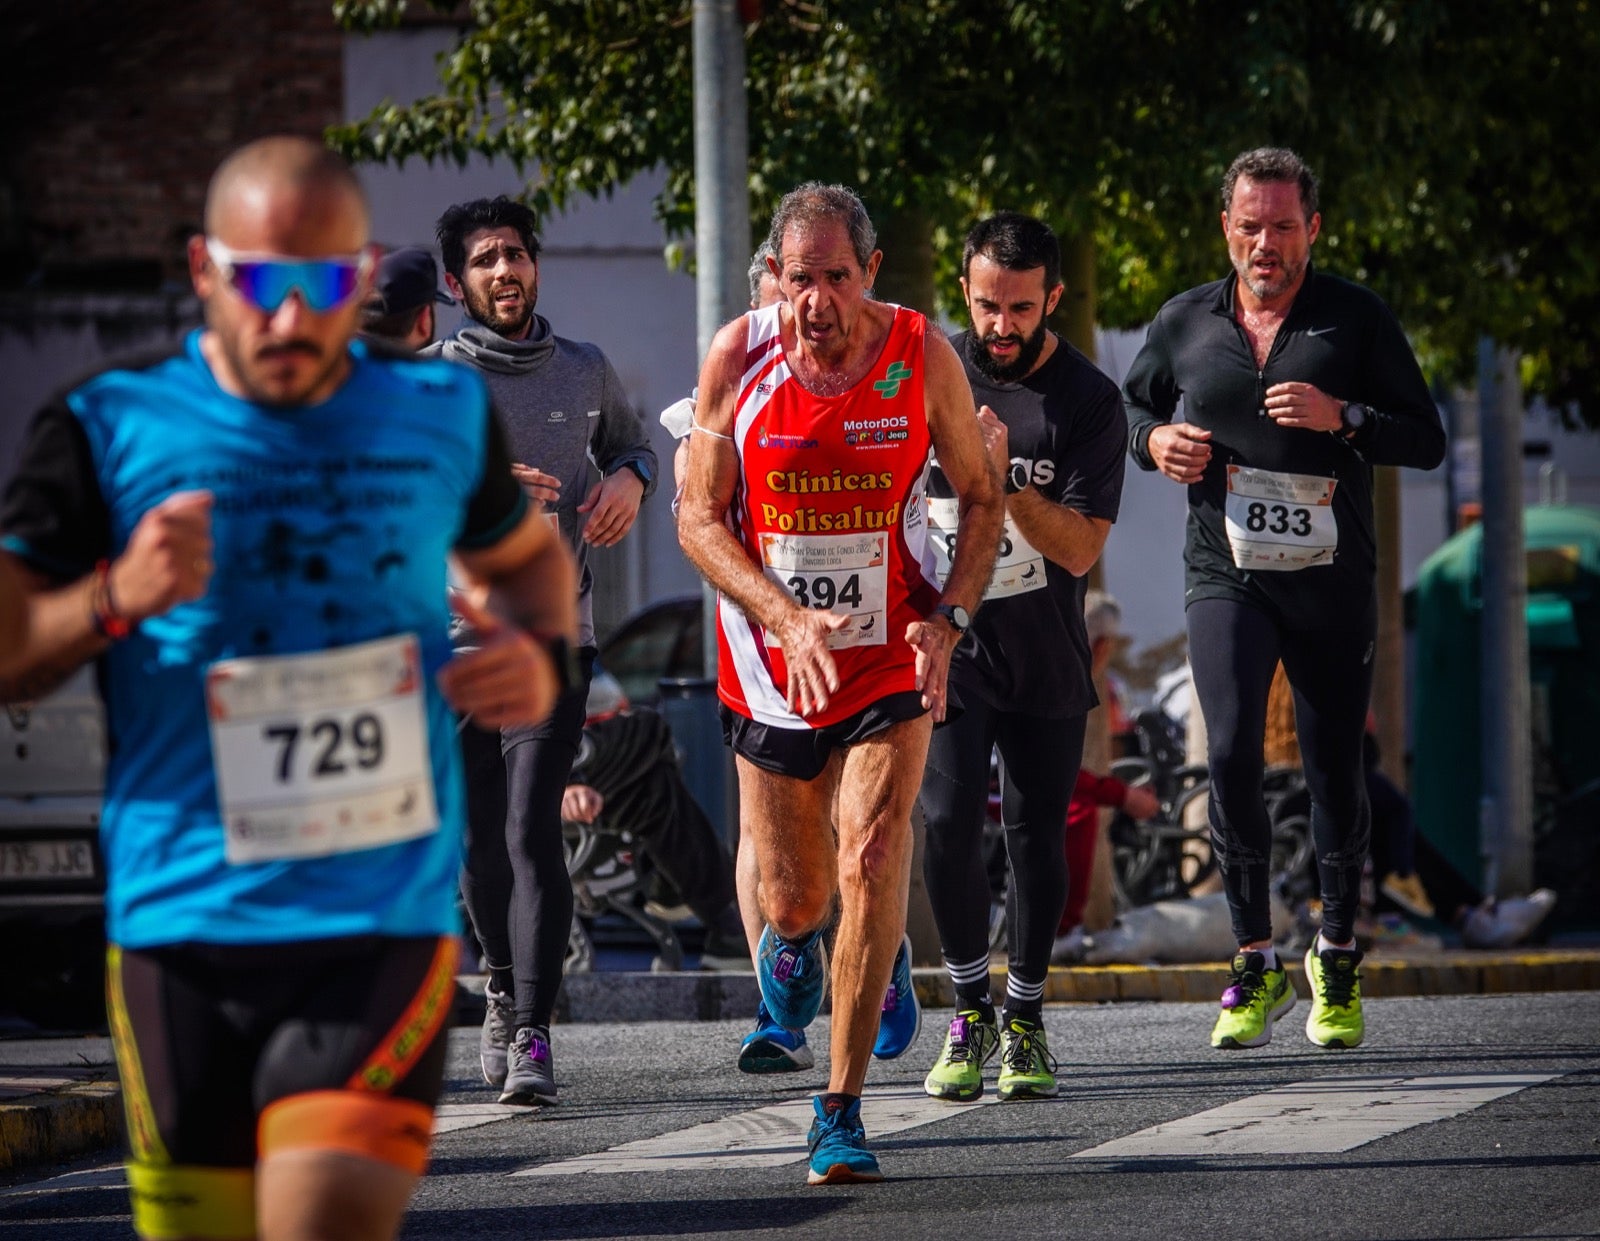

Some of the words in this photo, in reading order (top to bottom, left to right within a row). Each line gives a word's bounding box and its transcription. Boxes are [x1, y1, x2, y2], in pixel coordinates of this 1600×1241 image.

[843, 416, 908, 430] MotorDOS
[887, 431, 907, 440] Jeep
[766, 469, 893, 493] Clínicas
[761, 501, 900, 532] Polisalud
[1246, 502, 1312, 537] 833
[787, 574, 862, 610] 394
[264, 713, 384, 785] 729
